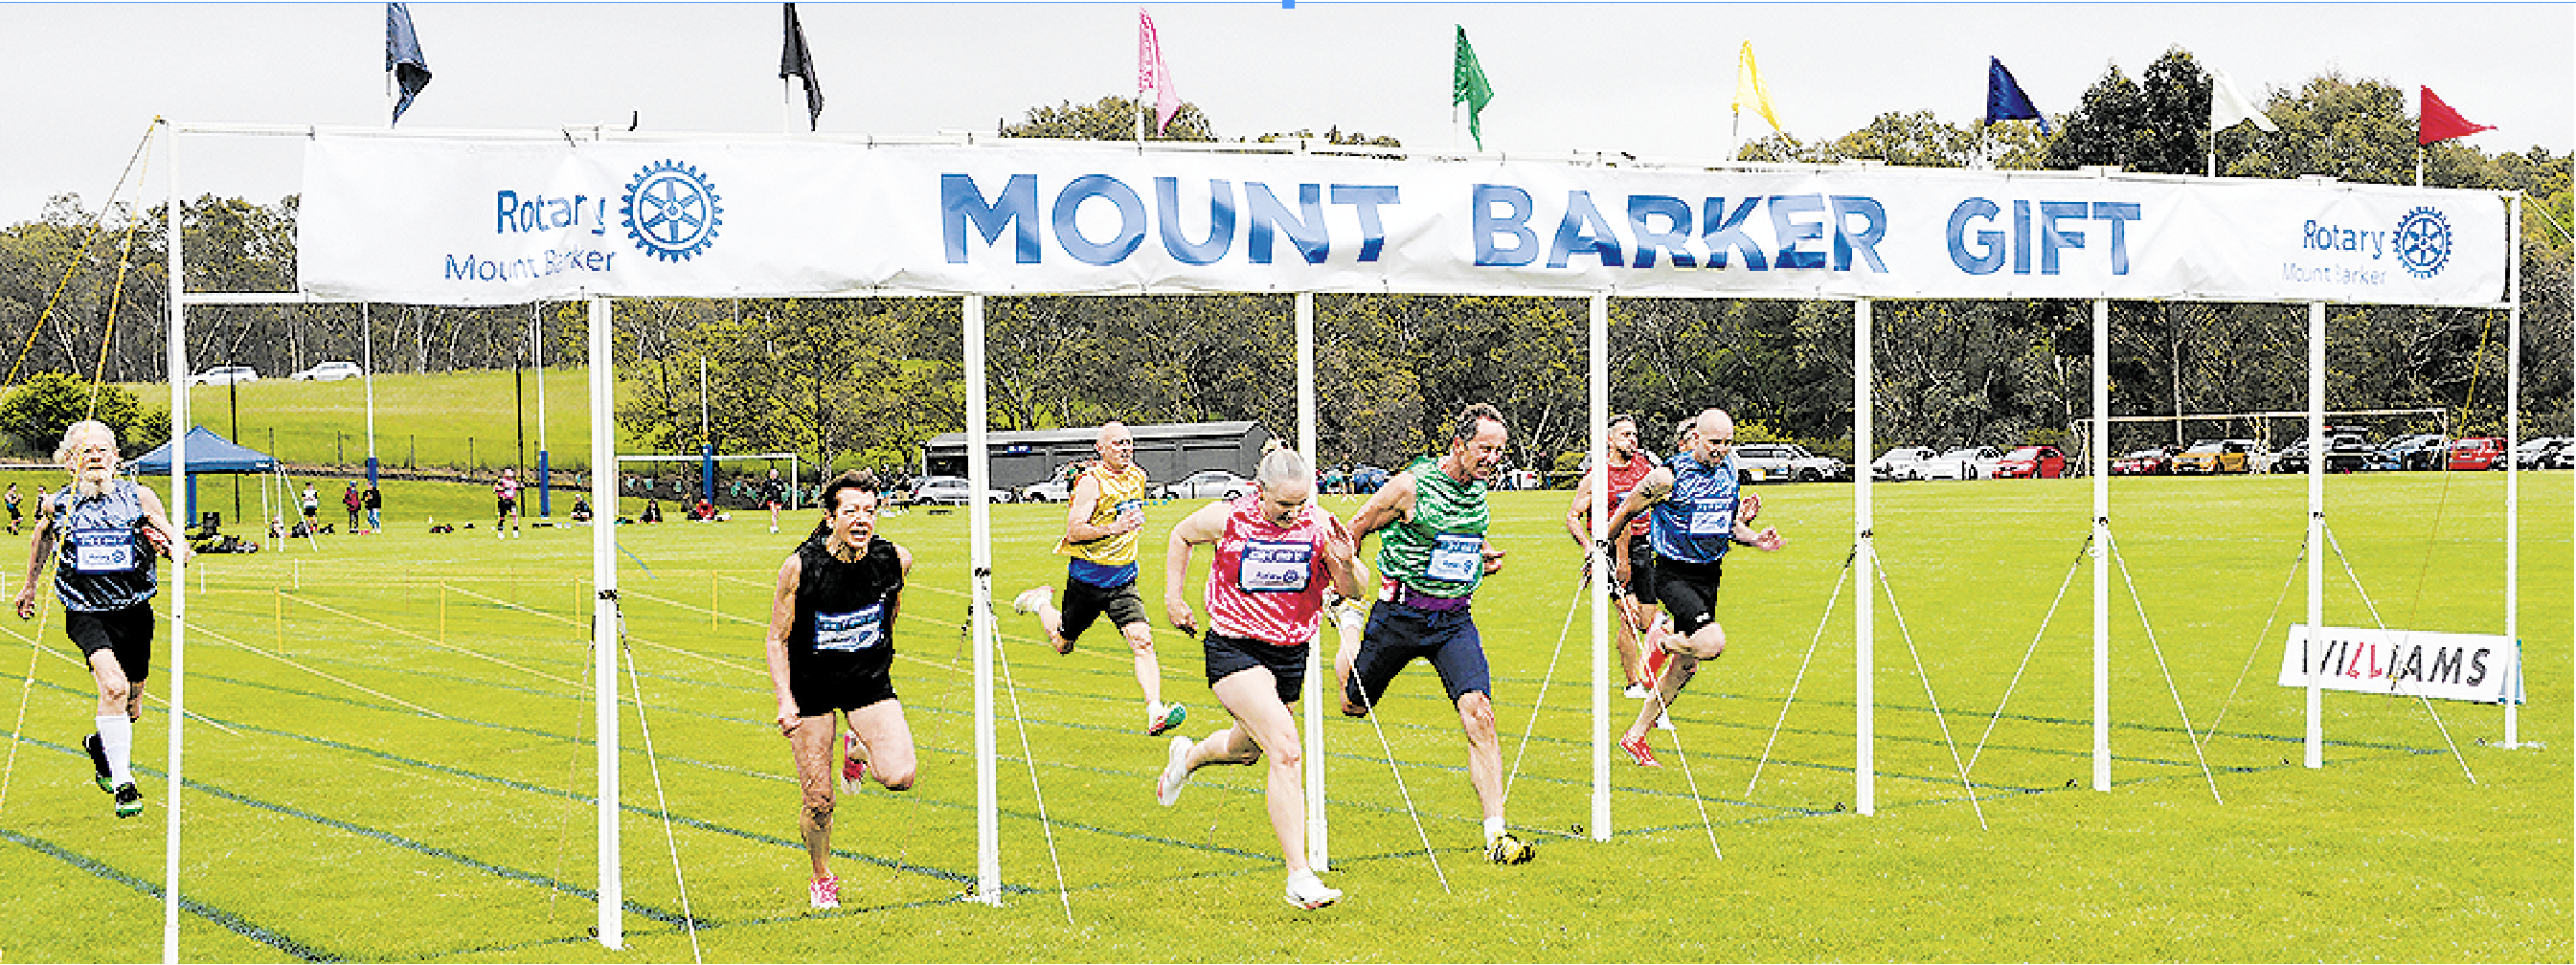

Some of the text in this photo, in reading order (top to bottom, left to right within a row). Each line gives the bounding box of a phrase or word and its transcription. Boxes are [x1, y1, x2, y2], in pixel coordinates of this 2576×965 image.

[496, 191, 606, 236] Rotary
[940, 173, 2141, 275] MOUNT BARKER GIFT
[2302, 219, 2385, 260] Rotary
[444, 254, 540, 281] Mount
[2281, 261, 2331, 283] Mount
